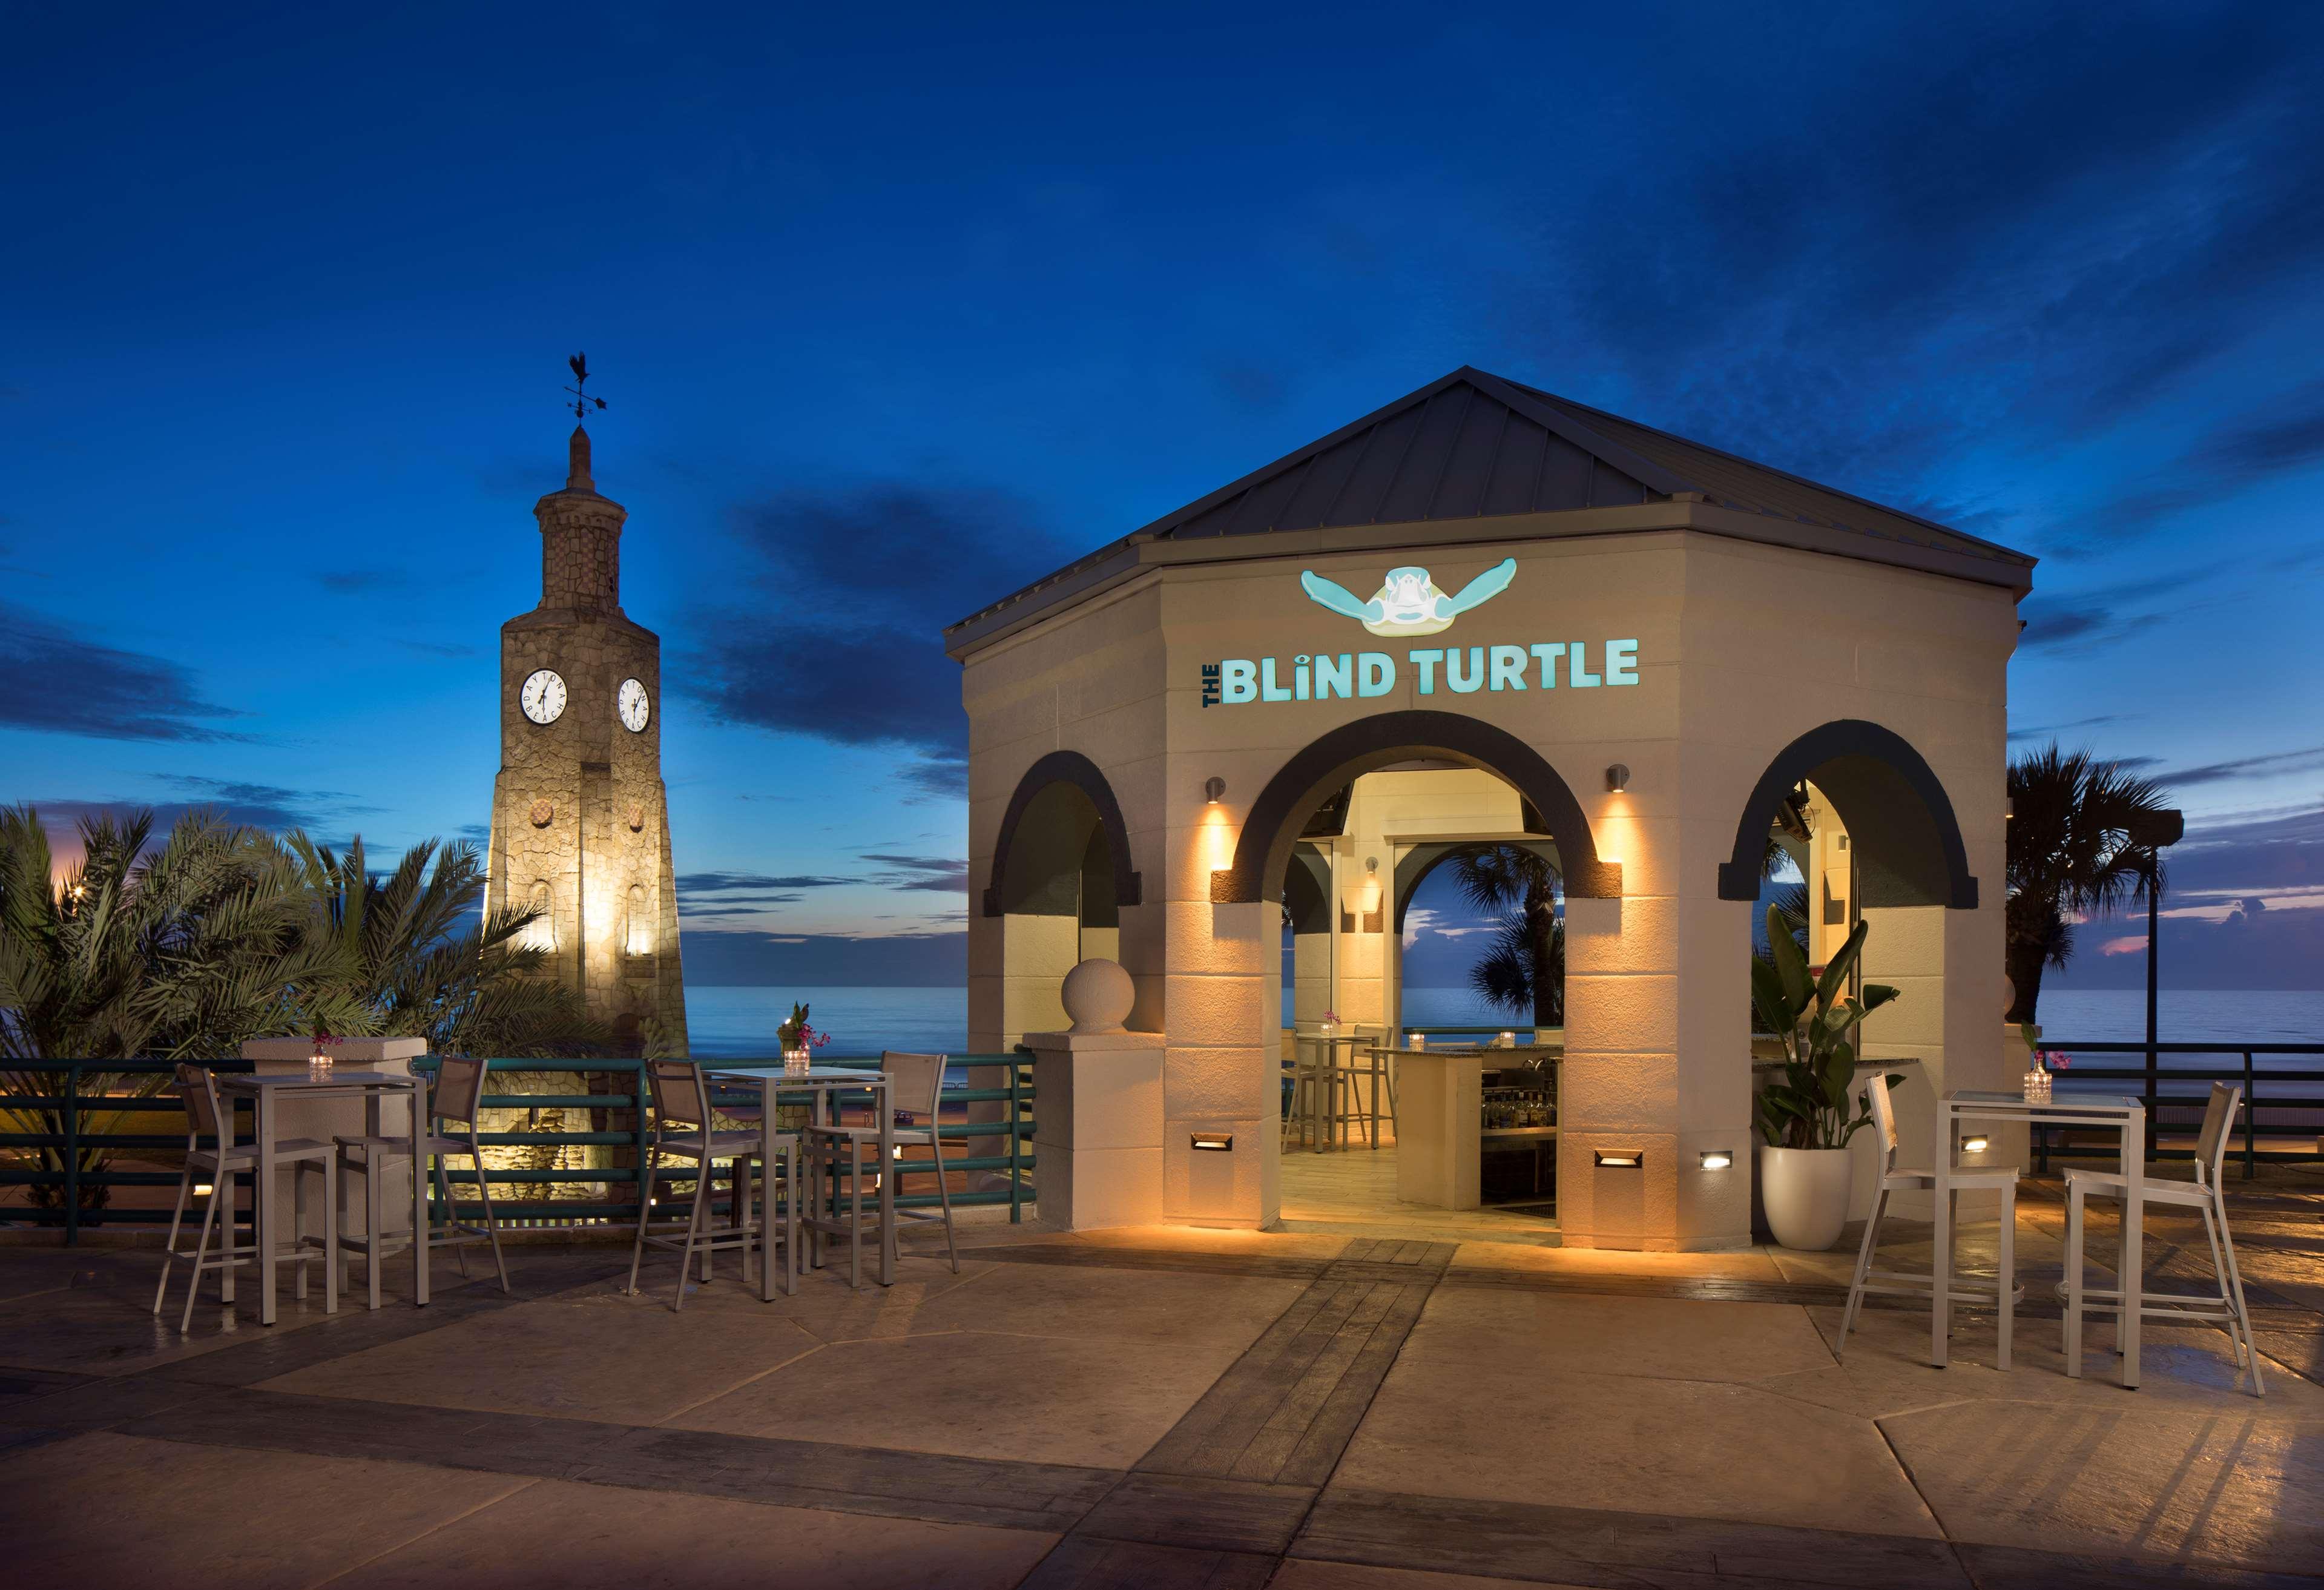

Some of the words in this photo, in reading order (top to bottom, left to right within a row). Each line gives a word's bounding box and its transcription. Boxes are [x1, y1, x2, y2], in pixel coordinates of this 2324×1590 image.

[523, 672, 565, 701] DAYTONA
[1202, 664, 1219, 708] THE
[1409, 638, 1639, 695] TURTLE
[525, 703, 564, 722] BEACH
